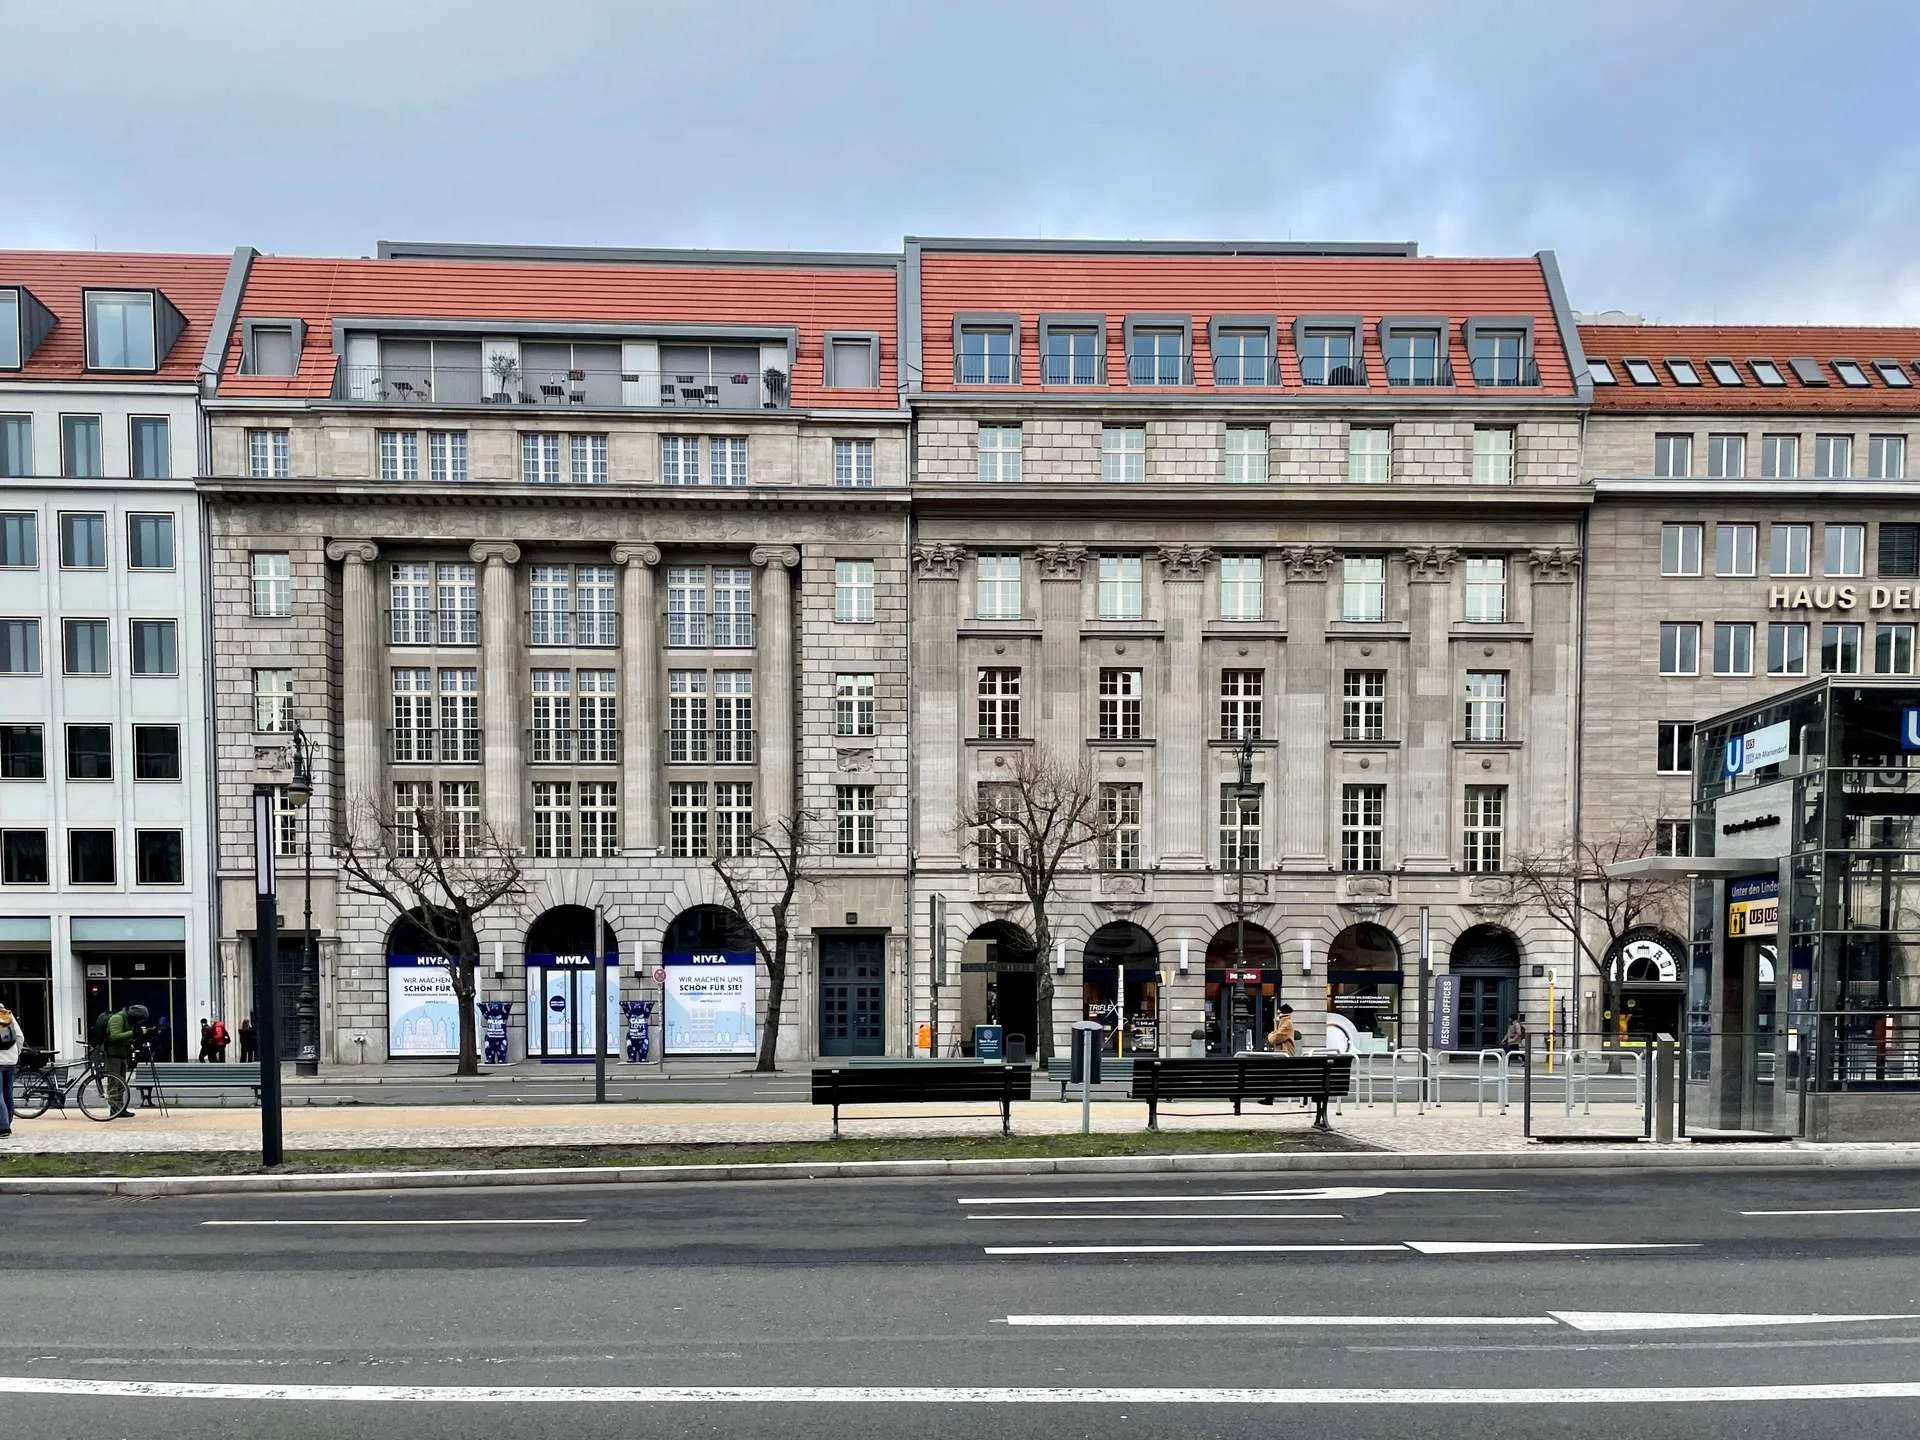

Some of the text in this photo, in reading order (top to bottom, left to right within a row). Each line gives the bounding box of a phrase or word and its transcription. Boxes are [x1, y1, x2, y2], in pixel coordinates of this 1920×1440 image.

[1768, 584, 1857, 609] HAUS
[1727, 738, 1742, 772] U
[1731, 886, 1748, 898] Unter
[1749, 883, 1760, 895] den
[1751, 908, 1778, 923] U5 U6
[417, 956, 450, 965] NIVEA
[556, 955, 590, 965] NIVEA
[693, 954, 726, 964] NIVEA
[404, 984, 451, 992] SCHÖN FÜR
[680, 983, 707, 991] SCHÖN
[710, 983, 725, 991] FÜR
[1441, 980, 1452, 1045] DESIGN OFFICES
